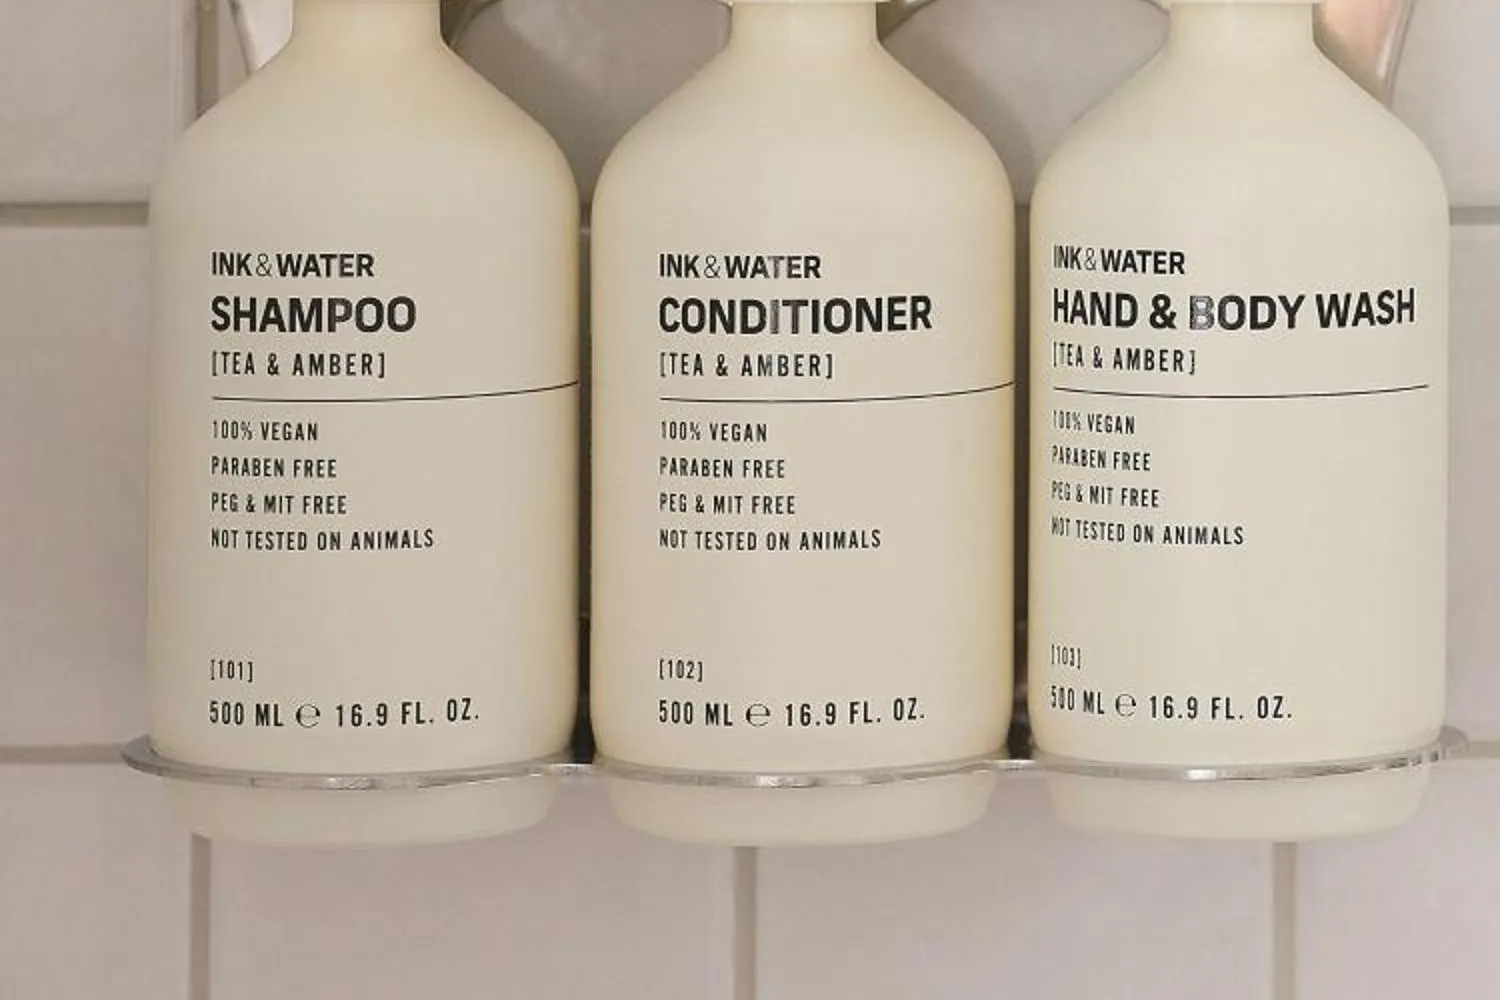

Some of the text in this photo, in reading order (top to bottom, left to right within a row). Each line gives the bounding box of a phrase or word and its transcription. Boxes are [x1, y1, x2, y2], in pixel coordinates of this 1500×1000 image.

[211, 251, 375, 279] INK&WATER
[659, 253, 822, 280] INK&WATER
[1053, 244, 1186, 275] INK&WATER
[210, 295, 417, 334] SHAMPOO
[659, 294, 933, 335] CONDITIONER
[1053, 287, 1416, 331] HAND & BODY WASH
[211, 350, 385, 379] [TEA & AMBER]
[659, 351, 833, 380] [TEA & AMBER]
[1052, 341, 1196, 376] [TEA & AMBER]
[212, 419, 318, 442] 100% VEGAN
[661, 420, 767, 443] 100% VEGAN
[1052, 409, 1135, 435] 100% VEGAN
[211, 455, 337, 479] PARABEN FREE
[659, 455, 785, 479] PARABEN FREE
[1051, 444, 1151, 472] PARABEN FREE
[211, 491, 347, 515] PEG & MIT FREE
[659, 492, 796, 515] PEG & MIT FREE
[1051, 480, 1071, 502] PEG
[1075, 483, 1084, 504] &
[1120, 487, 1160, 509] FREE
[211, 527, 434, 551] NOT TESTED ON ANIMALS
[659, 528, 881, 551] NOT TESTED ON ANIMALS
[1051, 516, 1244, 546] NOT TESTED ON ANIMALS
[209, 658, 253, 684] [101]
[658, 658, 703, 683] [102]
[209, 700, 245, 726] 500
[255, 703, 285, 728] ML
[335, 702, 389, 728] 16.9
[401, 700, 435, 726] FL.
[446, 697, 480, 723] OZ.
[659, 699, 694, 725] 500
[705, 702, 734, 727] ML
[785, 701, 837, 727] 16.9
[849, 700, 881, 725] FL.
[893, 696, 925, 722] OZ.
[1050, 684, 1075, 711] 500
[1082, 689, 1105, 715] ML
[1149, 695, 1199, 720] 16.9
[1211, 696, 1244, 721] FL.
[1257, 695, 1293, 720] OZ.
